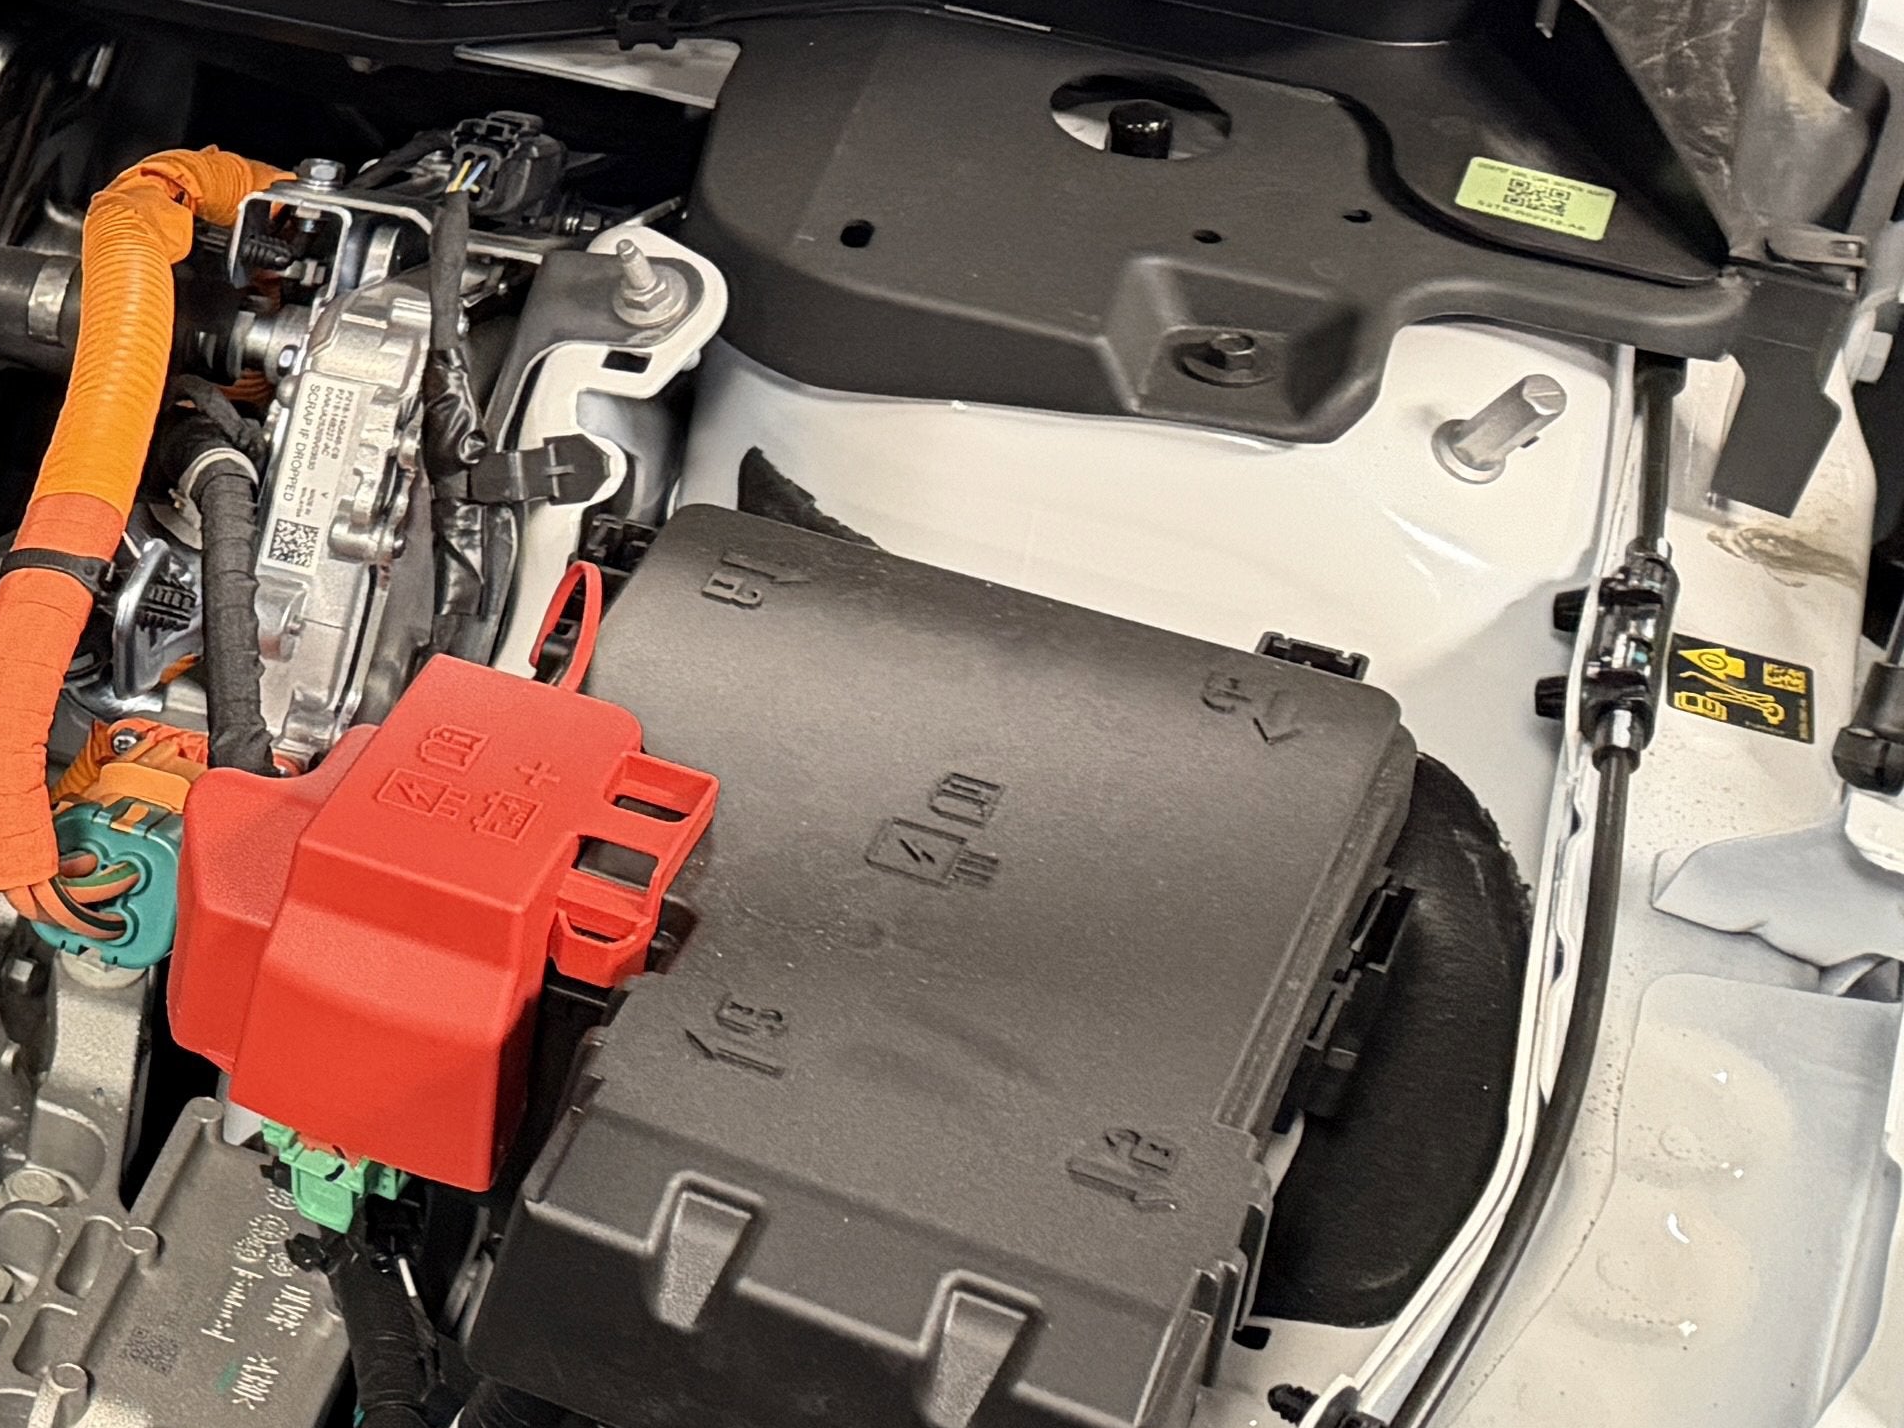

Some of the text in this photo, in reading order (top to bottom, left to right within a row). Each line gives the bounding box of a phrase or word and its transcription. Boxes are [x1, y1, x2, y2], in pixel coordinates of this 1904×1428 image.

[282, 383, 320, 502] SCRAP IF DROPPED
